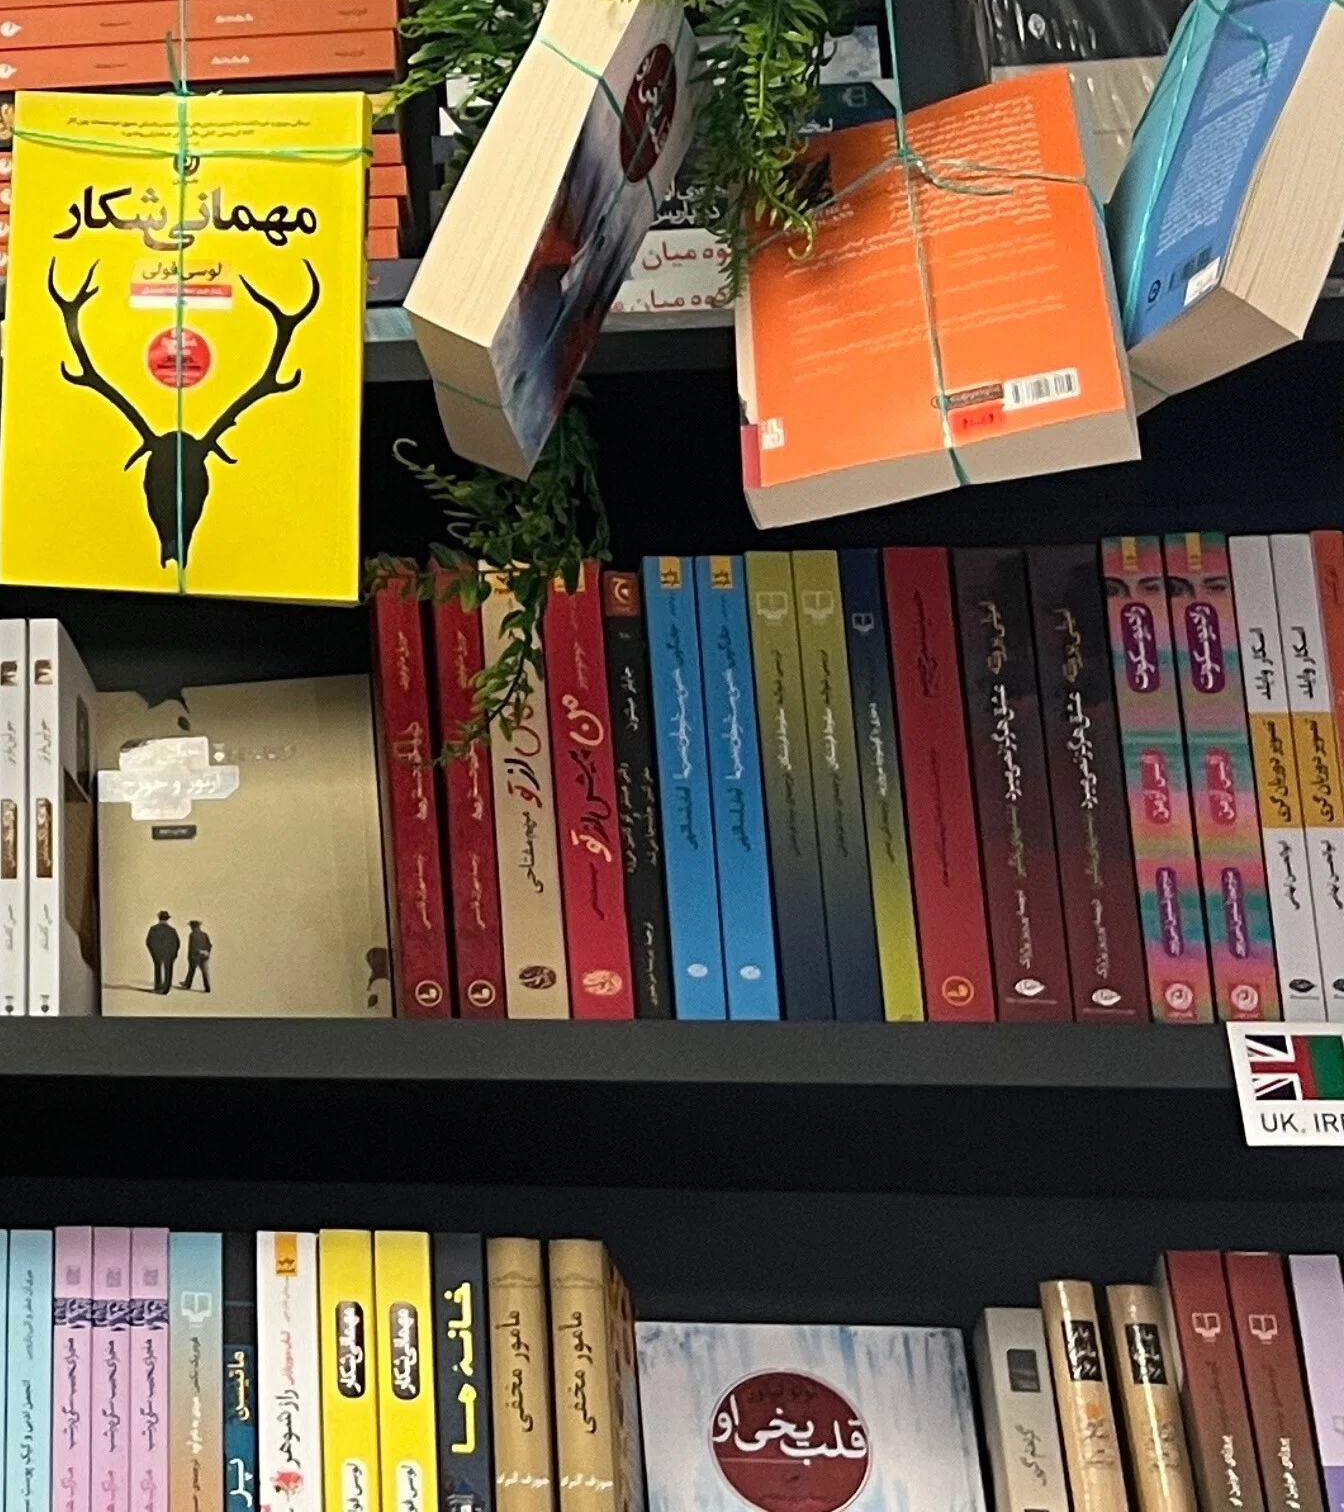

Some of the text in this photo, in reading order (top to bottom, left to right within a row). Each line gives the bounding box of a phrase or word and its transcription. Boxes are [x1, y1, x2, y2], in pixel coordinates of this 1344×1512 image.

[53, 185, 168, 240] شکار
[182, 261, 224, 282] لوسی
[642, 240, 697, 270] میان
[1124, 606, 1150, 690] رادیو سکوت
[1188, 605, 1214, 690] رادیو سکوت
[1248, 627, 1274, 701] اسکار وایلد
[1291, 625, 1317, 699] اسکار وایلد
[990, 684, 1014, 722] عشق
[1068, 691, 1090, 730] عشق
[507, 781, 542, 808] تو
[561, 692, 613, 862] من پیش تو
[495, 1311, 534, 1433] مأمور مخفی
[560, 1311, 597, 1435] مأمور مخفی
[21, 1380, 34, 1496] انجمن ادبی پوست
[274, 1388, 301, 1468] راز شوهر
[450, 1383, 477, 1454] ما
[713, 1394, 868, 1465] قلب یخی او
[227, 1457, 253, 1508] پر
